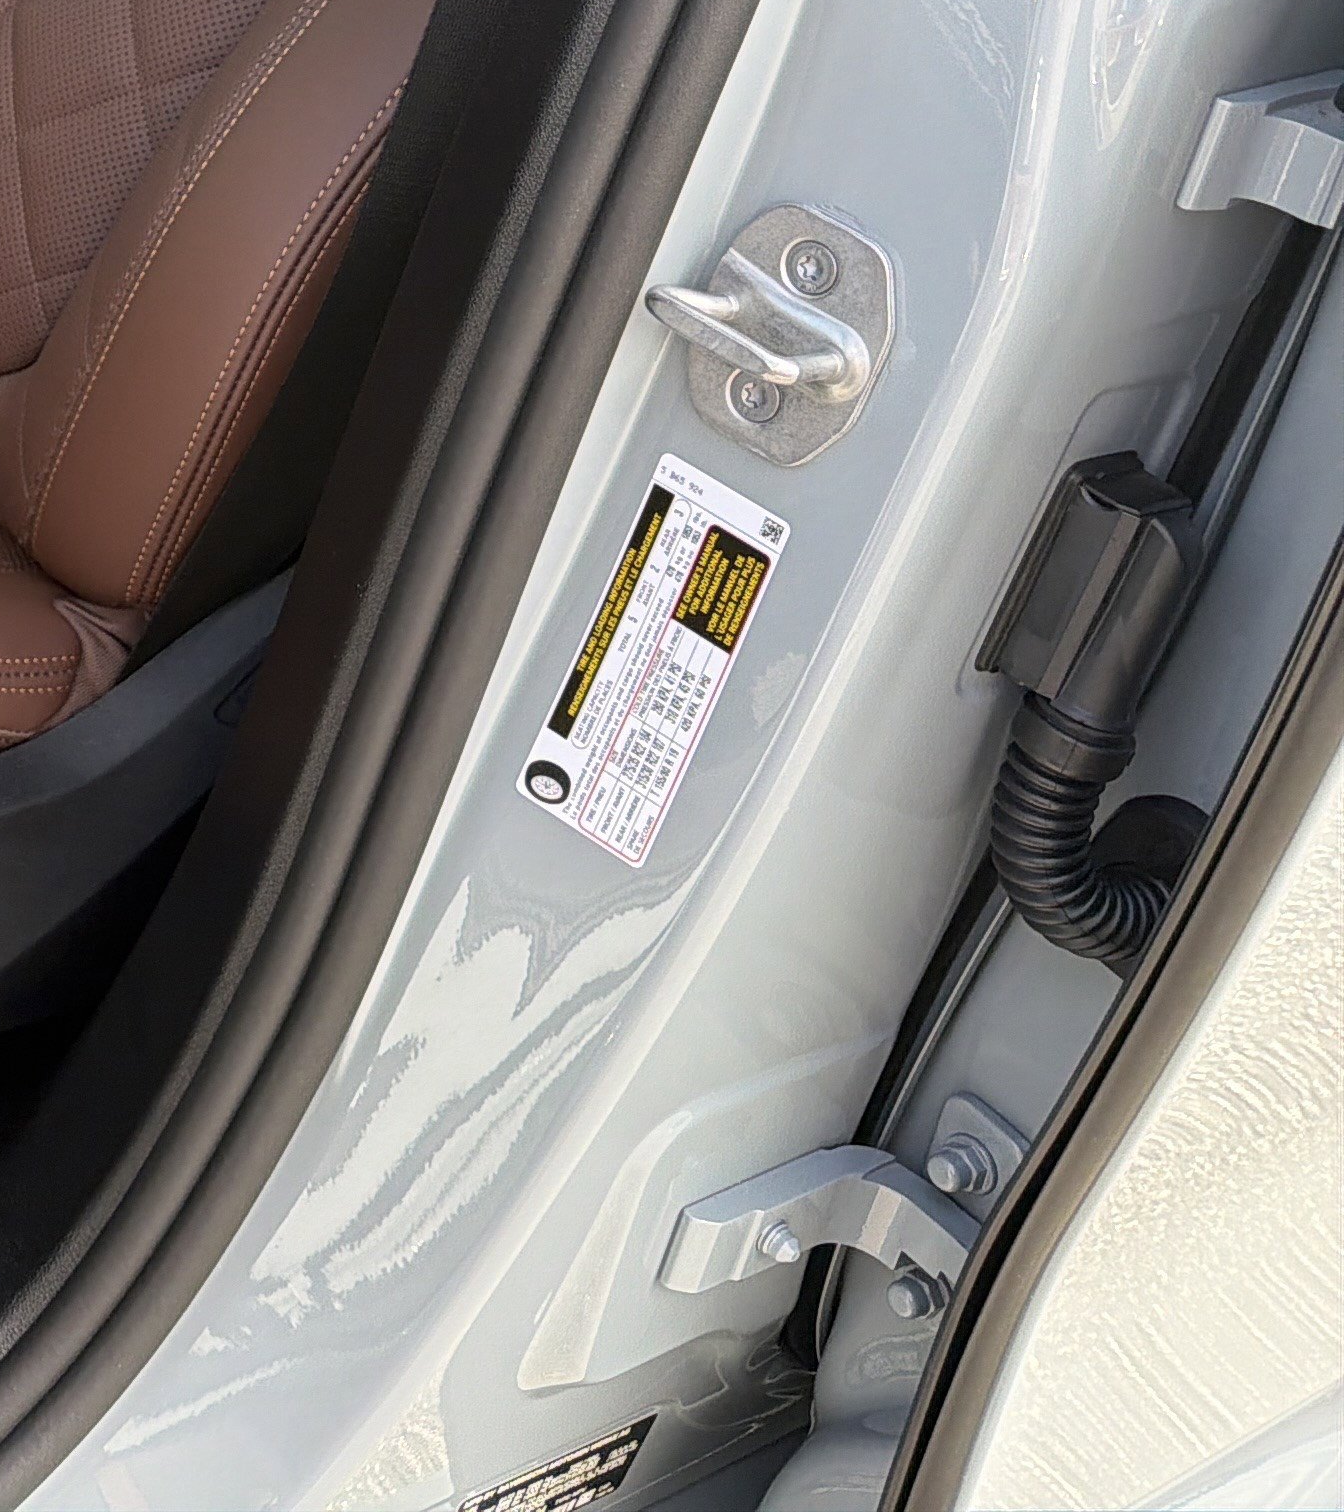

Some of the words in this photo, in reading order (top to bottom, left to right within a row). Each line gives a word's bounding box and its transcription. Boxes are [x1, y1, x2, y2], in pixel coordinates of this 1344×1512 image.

[661, 466, 667, 474] 5
[674, 509, 684, 517] 3
[660, 529, 671, 547] REAR
[636, 580, 649, 603] FRONT
[650, 564, 660, 573] 2
[675, 602, 689, 620] SEE
[683, 566, 703, 603] OWNER'S
[699, 533, 719, 566] MANUAL
[689, 597, 701, 615] FOR
[697, 550, 722, 597] ADDITIONAL
[701, 558, 729, 613] INFORMATION
[568, 648, 603, 716] RENSEIGNEMENTS
[599, 631, 610, 648] SUR
[606, 616, 617, 631] LES
[613, 590, 629, 616] PNEUS
[624, 578, 633, 590] ET
[629, 568, 639, 579] LE
[634, 513, 661, 567] CHARGEMENT
[577, 654, 590, 671] TIRE
[586, 637, 597, 654] AND
[593, 602, 613, 636] LOADING
[609, 548, 636, 602] INFORMATION
[642, 583, 655, 607] AVANT
[706, 613, 720, 632] VOIR
[715, 602, 725, 613] LE
[720, 569, 739, 602] MANUEL
[734, 555, 745, 568] DE
[715, 602, 736, 640] L'USAGER
[731, 578, 746, 602] POUR
[741, 556, 755, 578] PLUS
[723, 633, 734, 646] DE
[729, 563, 764, 633] RENSEIGNEMENTS
[618, 633, 631, 652] TOTAL
[628, 615, 638, 623] 5
[632, 696, 643, 714] COLD
[640, 681, 650, 694] TIRE
[646, 648, 664, 680] PRESSURE
[638, 687, 655, 718] PRESSION
[652, 674, 661, 686] DES
[659, 652, 671, 673] PNEUS
[670, 627, 682, 646] FROID
[695, 688, 705, 699] 60
[699, 674, 711, 689] PSI
[562, 802, 572, 814] The
[571, 768, 587, 800] combined
[585, 744, 598, 768] weight
[596, 735, 602, 744] of
[600, 702, 618, 735] occupants
[616, 687, 624, 701] and
[622, 668, 633, 687] cargo
[631, 643, 644, 666] should
[642, 623, 653, 642] never
[651, 598, 664, 622] exceed
[574, 713, 590, 740] SEATING
[587, 681, 604, 712] CAPACITY
[581, 716, 596, 744] NOMBRE
[594, 705, 601, 715] DE
[598, 680, 613, 705] PLACES
[681, 717, 693, 732] 420
[616, 728, 637, 768] DIMENSIONS
[601, 811, 613, 833] FRONT
[613, 787, 625, 808] AVANT
[615, 825, 627, 843] REAR
[633, 845, 641, 854] DE
[638, 815, 654, 844] SECOURS
